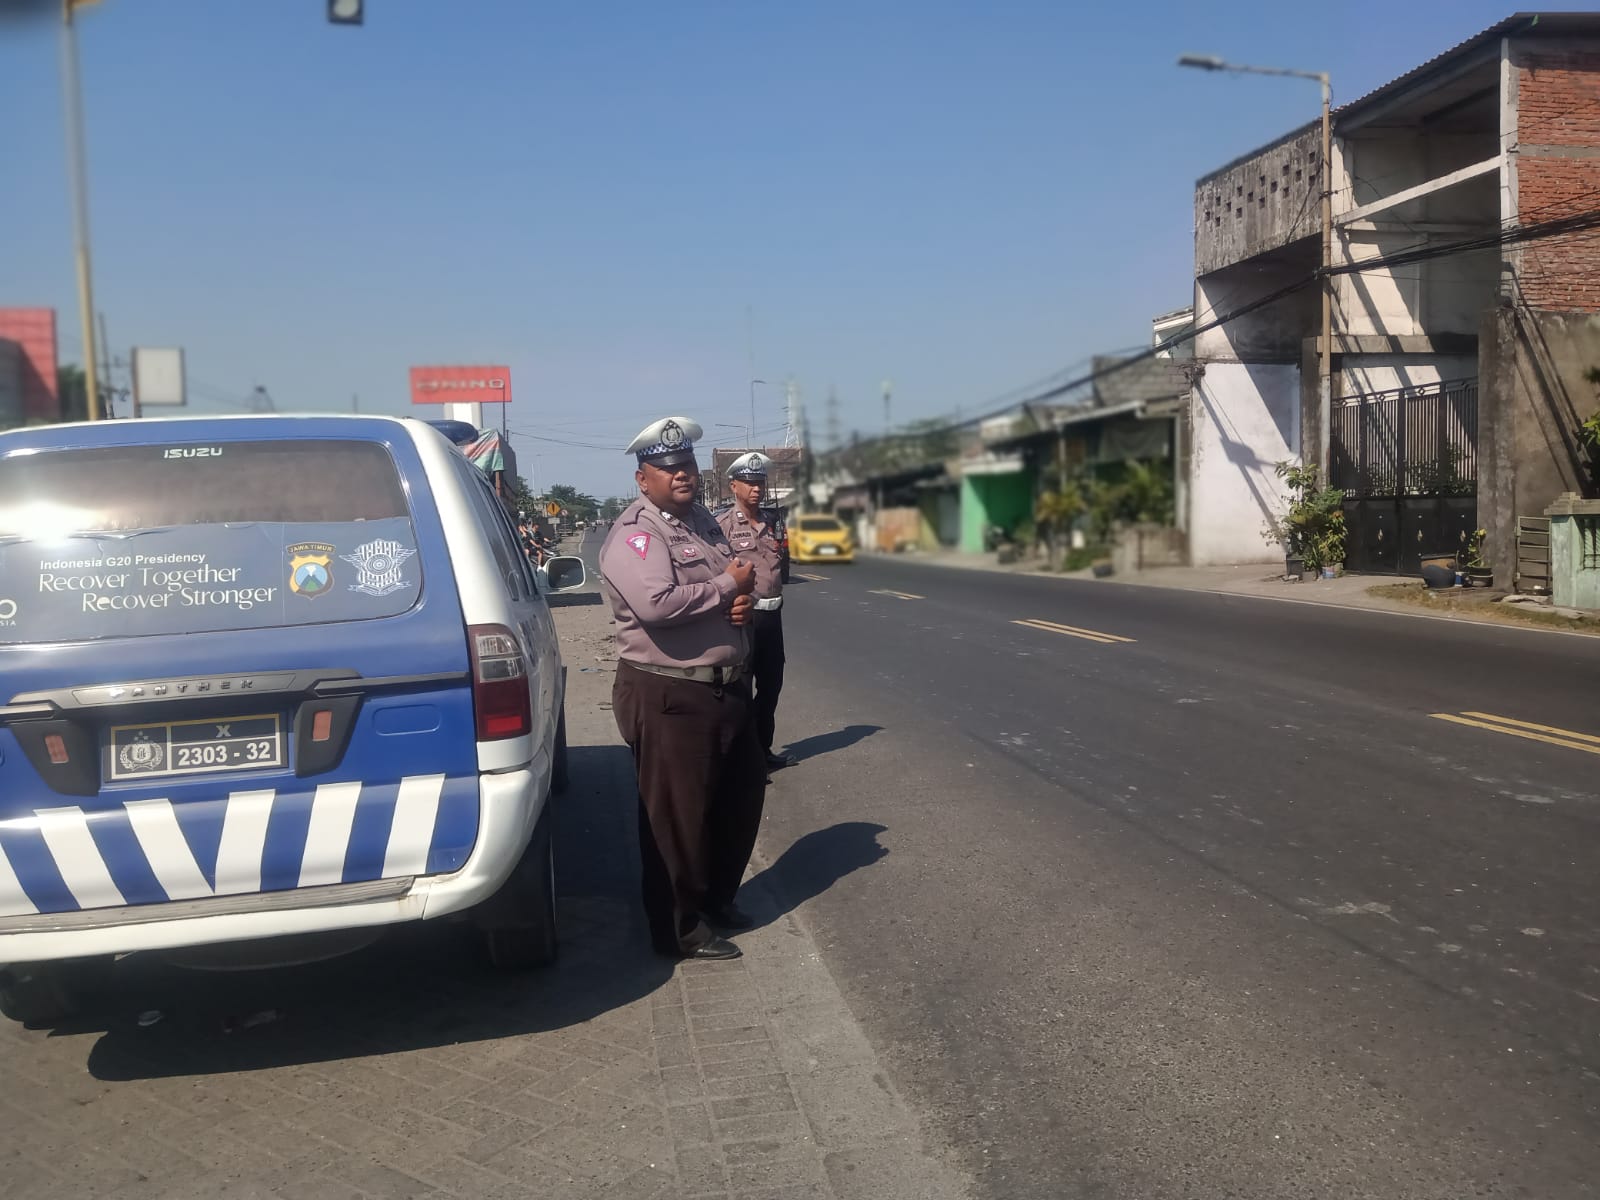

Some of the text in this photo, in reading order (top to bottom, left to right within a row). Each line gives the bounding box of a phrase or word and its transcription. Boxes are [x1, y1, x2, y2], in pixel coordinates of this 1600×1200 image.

[163, 447, 223, 459] ISUZU
[290, 544, 333, 553] JAWA TIMUR
[40, 553, 206, 570] Indonesia G20 Presidency
[39, 563, 242, 592] Recover Together
[82, 587, 277, 612] Recover Stronger
[216, 724, 231, 738] X
[178, 745, 228, 766] 2303
[246, 741, 271, 760] 32
